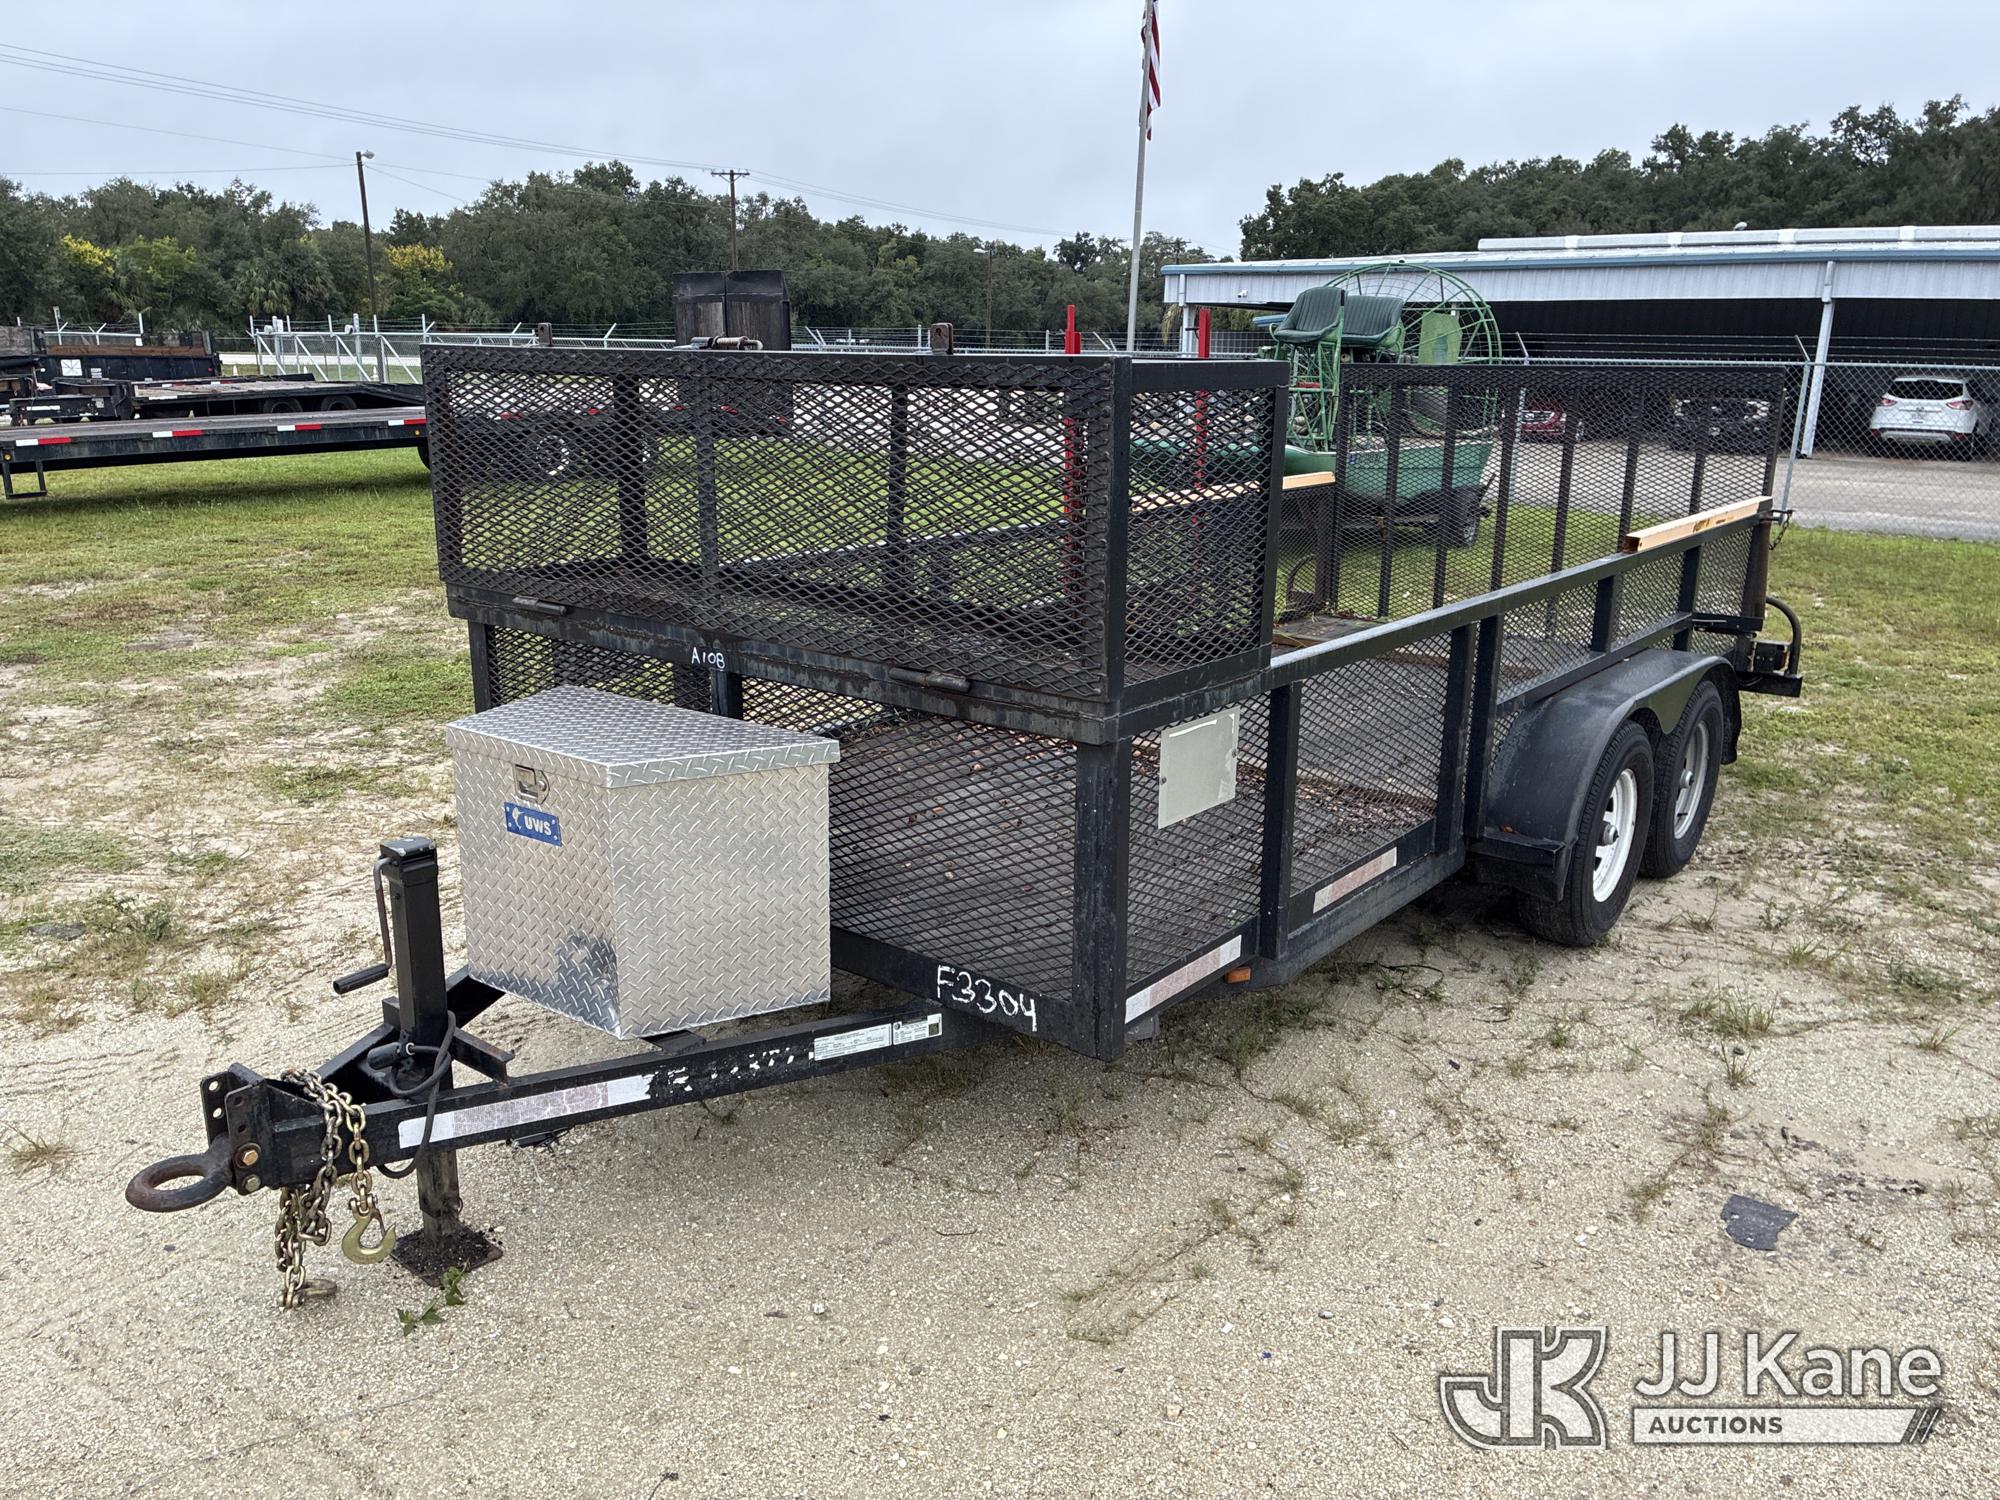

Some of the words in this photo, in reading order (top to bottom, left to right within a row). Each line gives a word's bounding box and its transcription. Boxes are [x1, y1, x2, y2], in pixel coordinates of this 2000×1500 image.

[691, 646, 726, 669] A108
[524, 815, 552, 836] UWS
[937, 965, 1037, 1032] F3304
